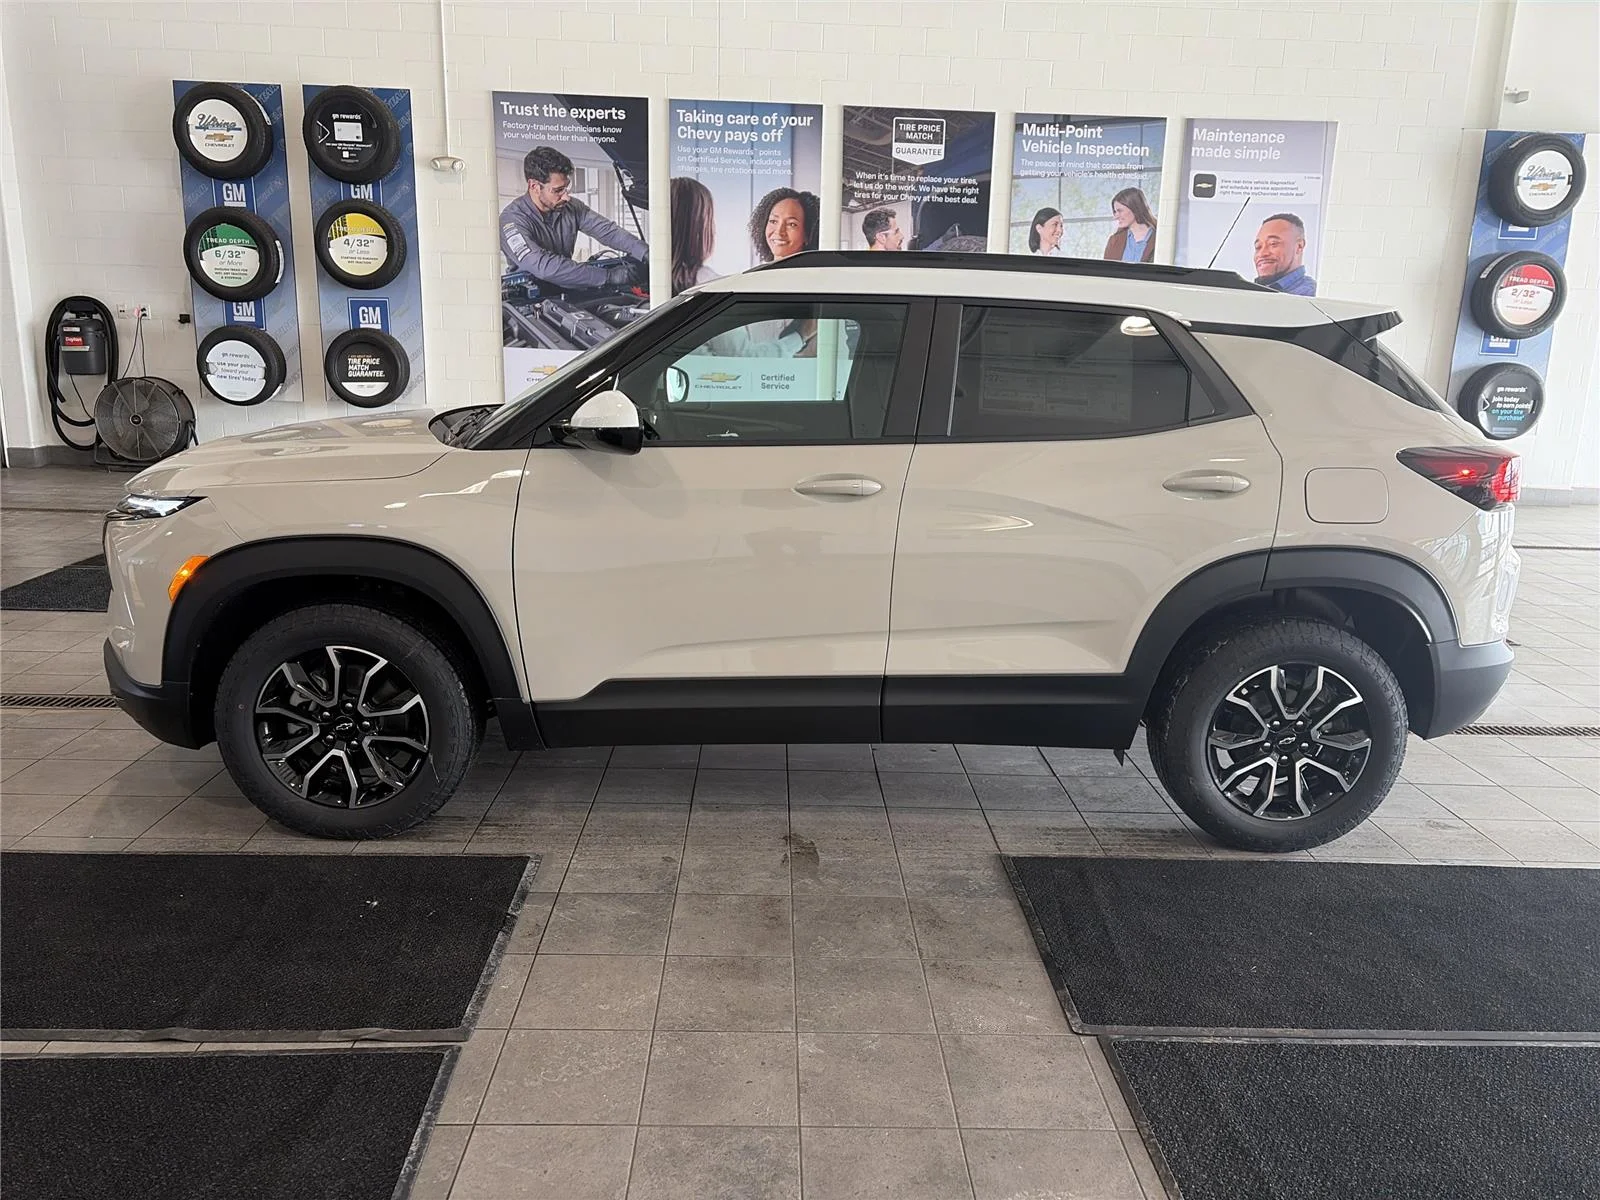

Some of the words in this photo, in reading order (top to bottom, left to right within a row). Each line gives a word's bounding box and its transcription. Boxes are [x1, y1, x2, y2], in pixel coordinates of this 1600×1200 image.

[500, 102, 540, 117] Trust
[542, 104, 567, 118] the
[570, 106, 626, 122] experts
[676, 110, 724, 126] Taking
[726, 114, 759, 126] care
[762, 112, 778, 126] of
[781, 116, 814, 128] your
[502, 121, 559, 132] Factory-trained
[560, 124, 601, 133] technicians
[602, 125, 622, 134] know
[899, 123, 916, 132] TIRE
[918, 124, 941, 132] PRICE
[1022, 122, 1103, 138] Multi-Point
[520, 132, 546, 140] vehicle
[547, 133, 570, 142] better
[677, 126, 721, 142] Chevy
[724, 130, 758, 144] pays
[762, 129, 784, 142] off
[906, 132, 933, 140] MATCH
[1193, 128, 1286, 144] Maintenance
[759, 149, 781, 157] points
[895, 147, 942, 156] GUARANTEE
[1022, 140, 1072, 154] Vehicle
[1076, 142, 1149, 157] Inspection
[1191, 145, 1231, 158] made
[1234, 146, 1281, 162] simple
[688, 155, 719, 164] Certified
[720, 156, 749, 165] Service,
[750, 158, 782, 167] including
[1066, 160, 1085, 168] mind
[678, 165, 709, 174] changes,
[758, 167, 771, 175] and
[856, 171, 876, 179] When
[878, 172, 888, 180] it's
[890, 173, 906, 182] time
[916, 175, 942, 184] replace
[961, 177, 978, 185] tires,
[223, 183, 246, 201] GM
[351, 184, 372, 199] GM
[932, 185, 948, 193] have
[962, 186, 979, 195] right
[900, 193, 922, 202] Chevy
[932, 194, 943, 203] the
[344, 238, 374, 248] 4/32"
[215, 250, 245, 260] 6/32"
[1512, 288, 1540, 298] 2/32"
[233, 301, 255, 316] GM
[359, 306, 381, 324] GM
